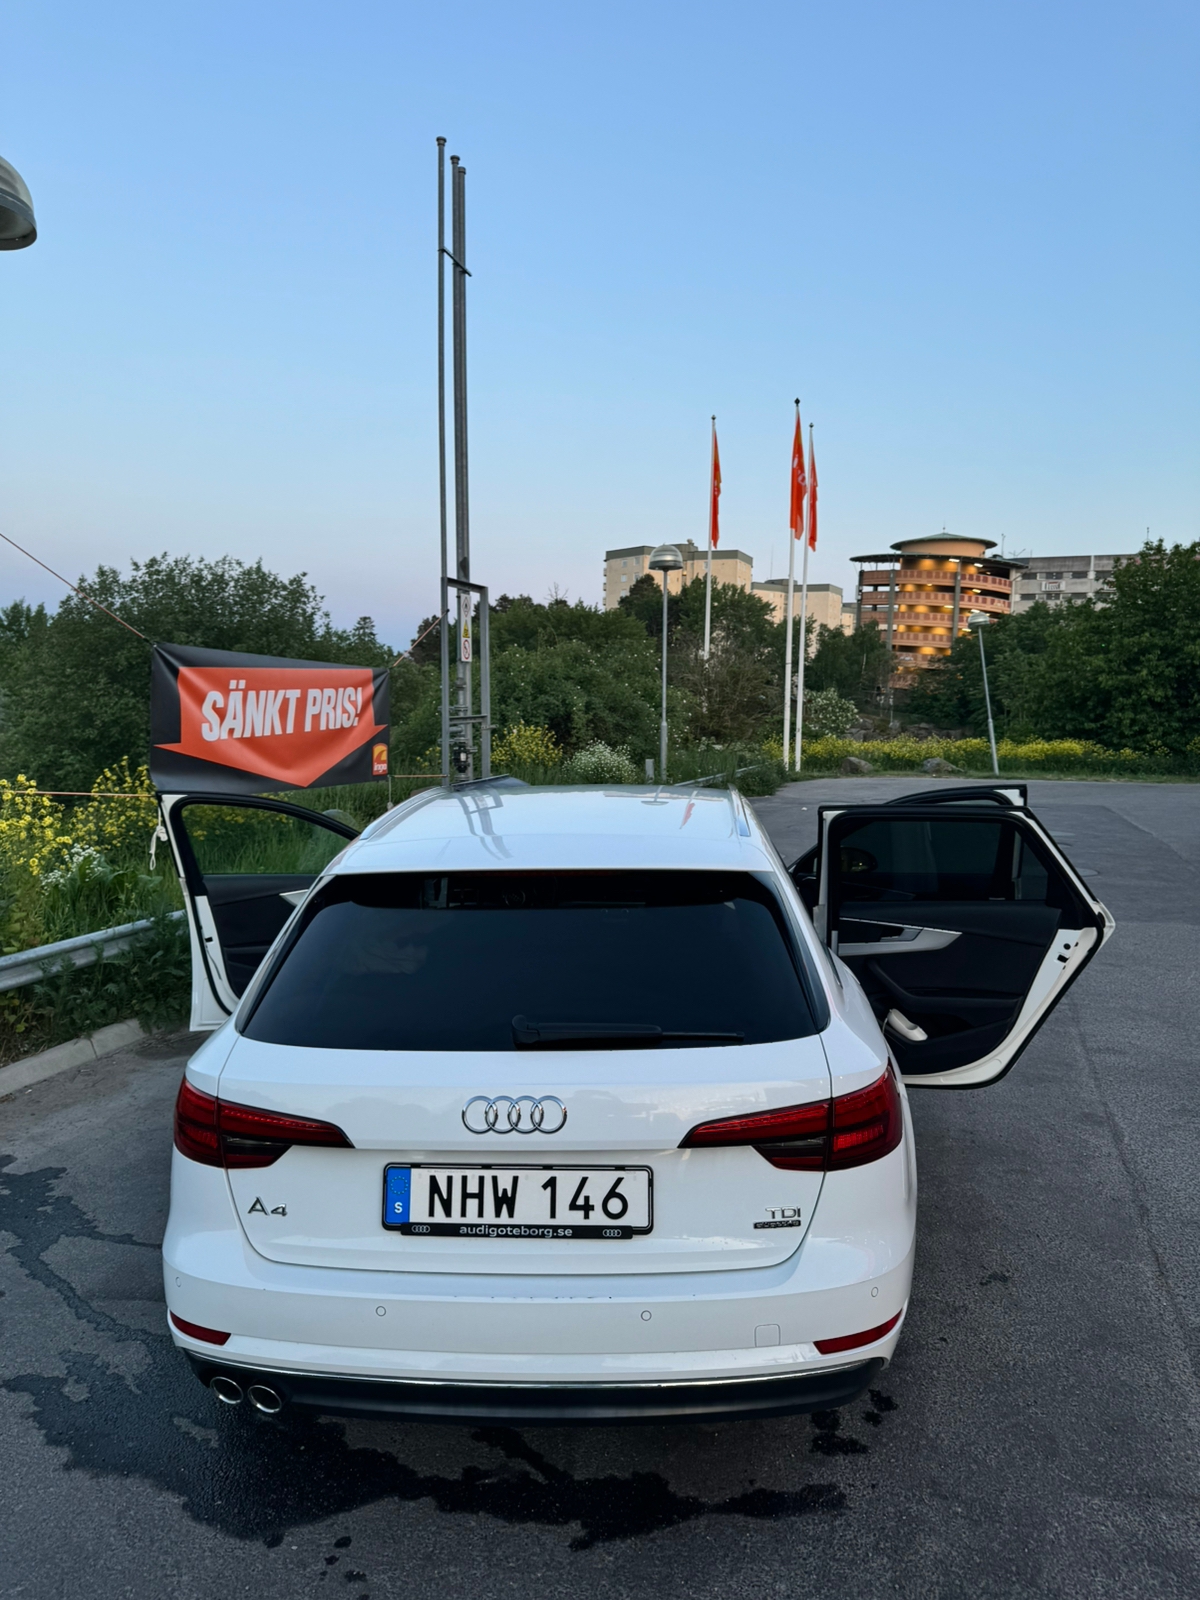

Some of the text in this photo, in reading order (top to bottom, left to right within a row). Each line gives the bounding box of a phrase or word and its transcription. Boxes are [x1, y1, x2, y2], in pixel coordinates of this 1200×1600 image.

[201, 679, 363, 742] SÄNKT PRIS!
[428, 1174, 629, 1221] NHW 146
[247, 1196, 288, 1217] A4
[394, 1202, 403, 1214] S
[765, 1206, 801, 1219] TDI
[459, 1225, 573, 1239] audigoteborg.se
